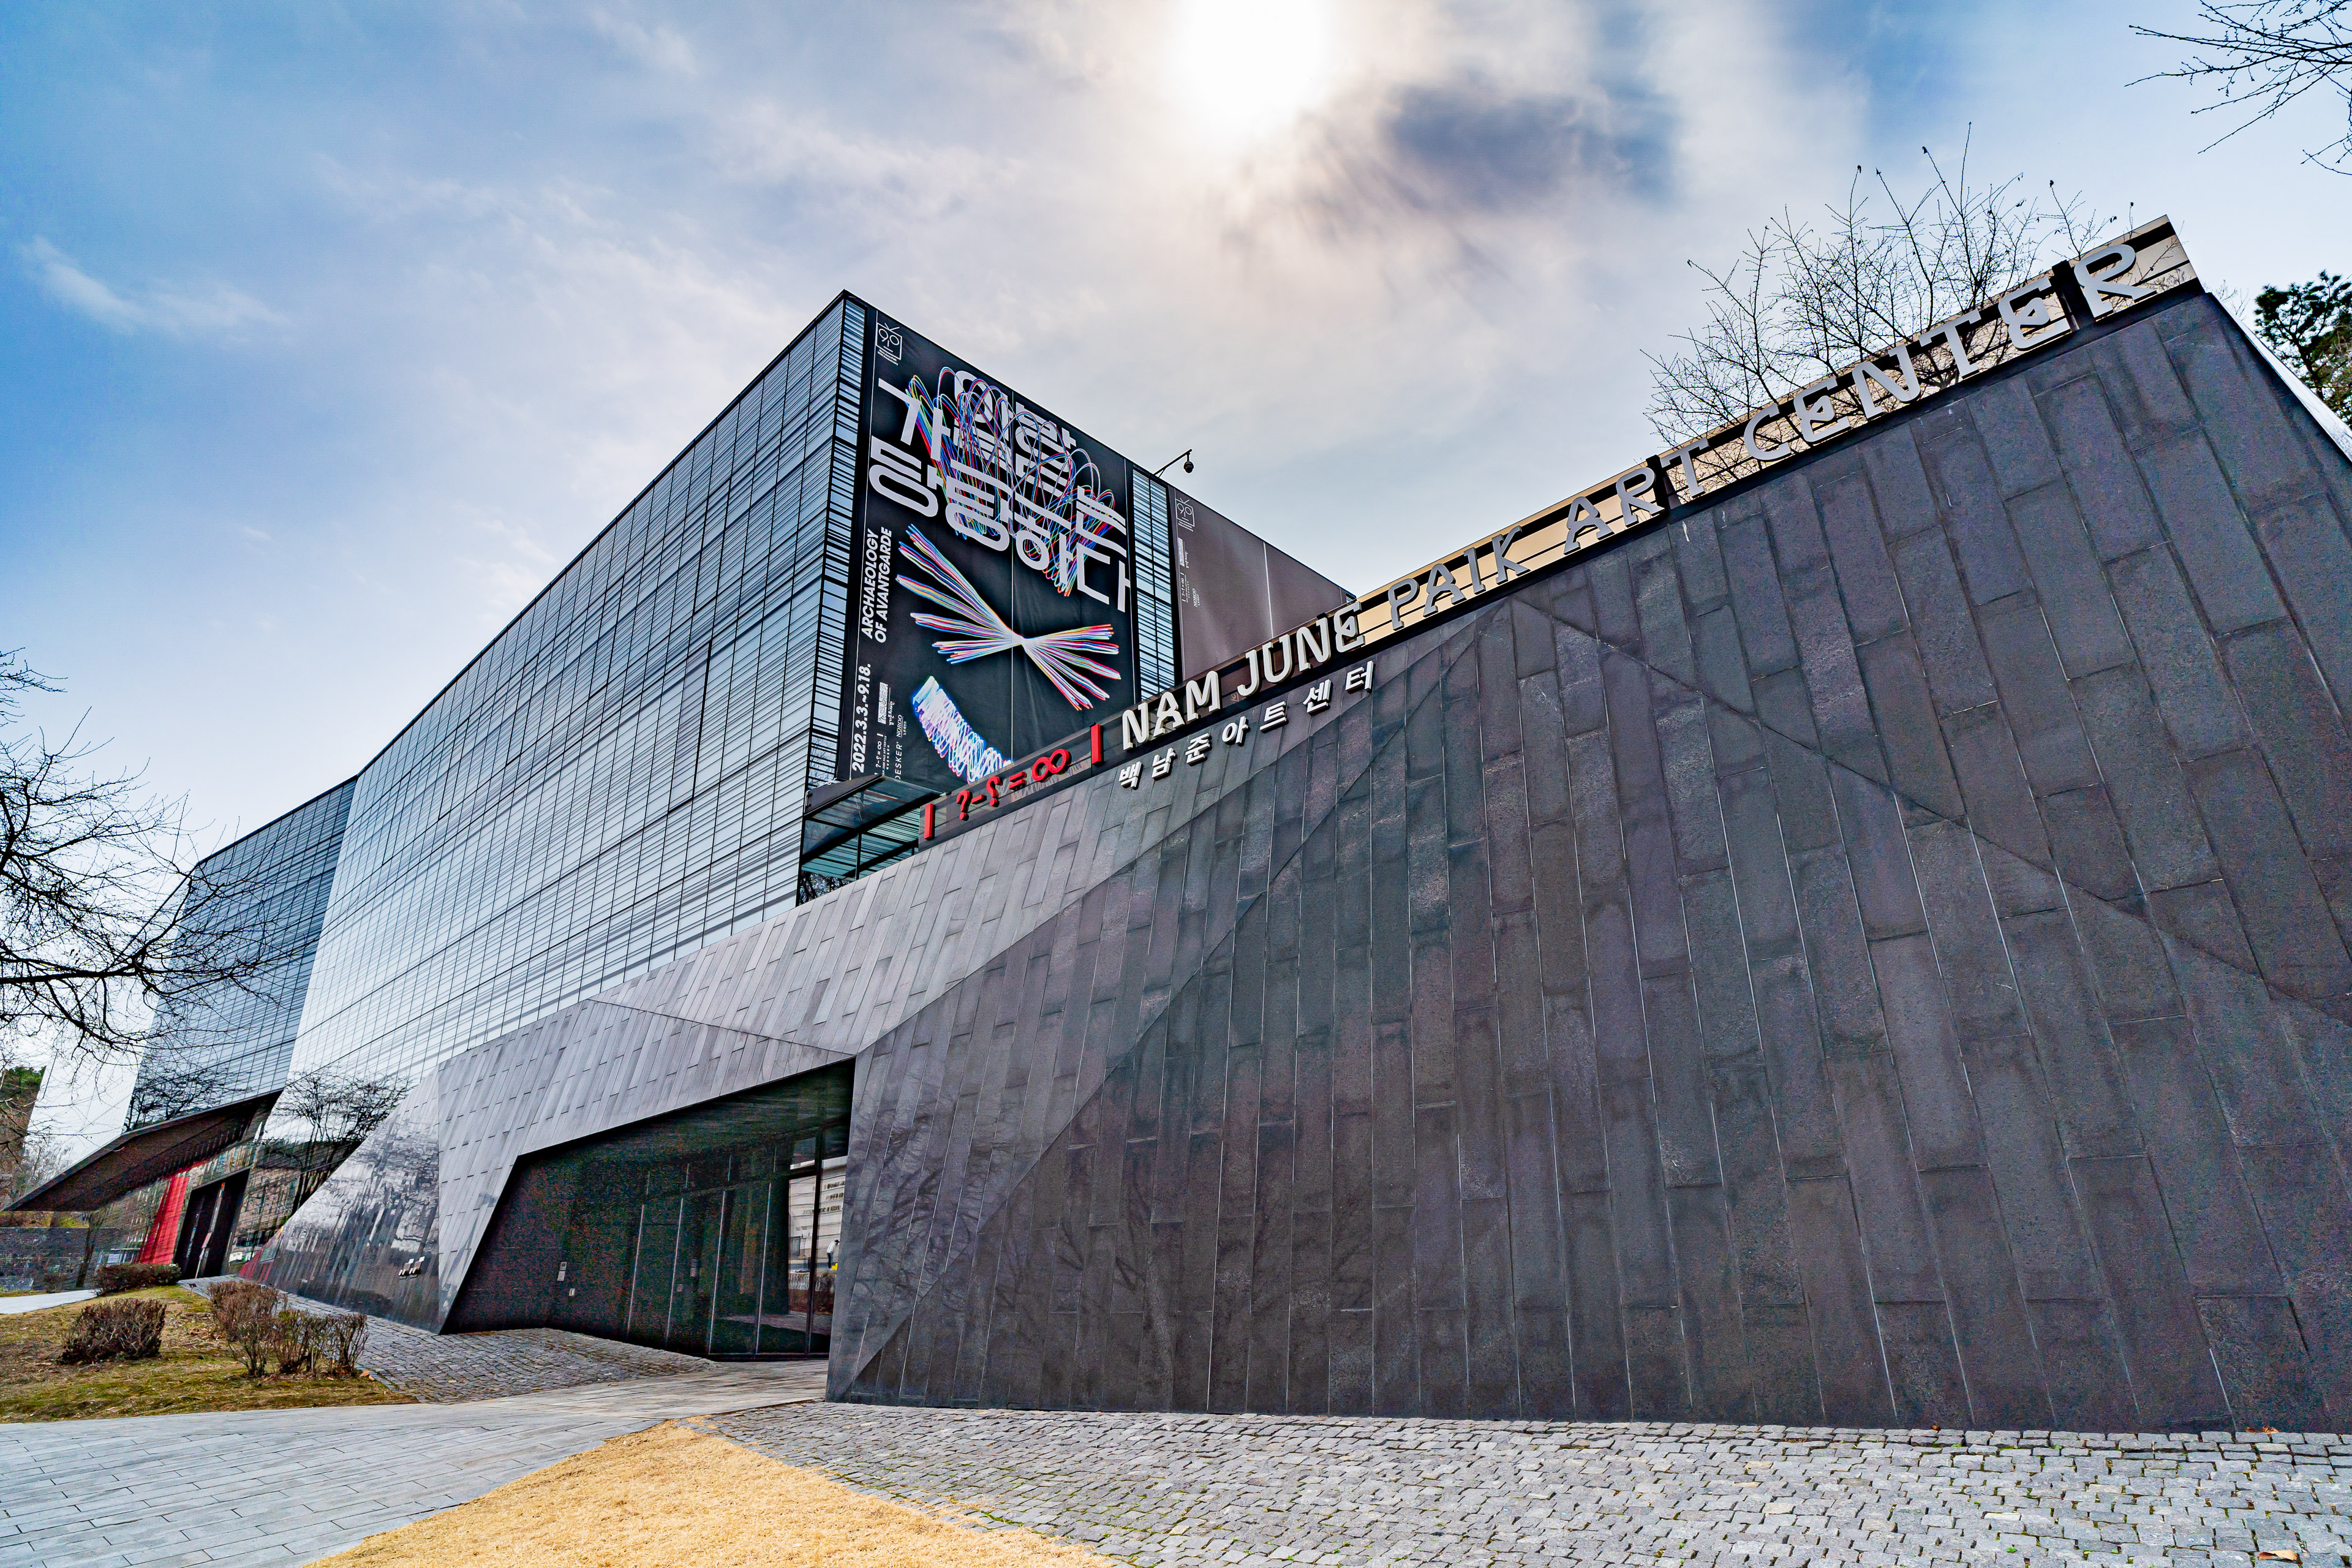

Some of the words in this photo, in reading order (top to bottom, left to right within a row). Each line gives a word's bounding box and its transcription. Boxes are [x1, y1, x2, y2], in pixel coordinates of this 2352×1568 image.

[1122, 671, 1220, 751] NAM
[1237, 601, 1366, 696] JUNE
[1387, 526, 1531, 631] PAIK
[1563, 437, 1709, 556] ART
[1744, 244, 2157, 463] CENTER
[861, 528, 878, 639] ARCHAEOLOGY
[876, 527, 892, 621] AVANTGARDE
[875, 622, 887, 643] OF
